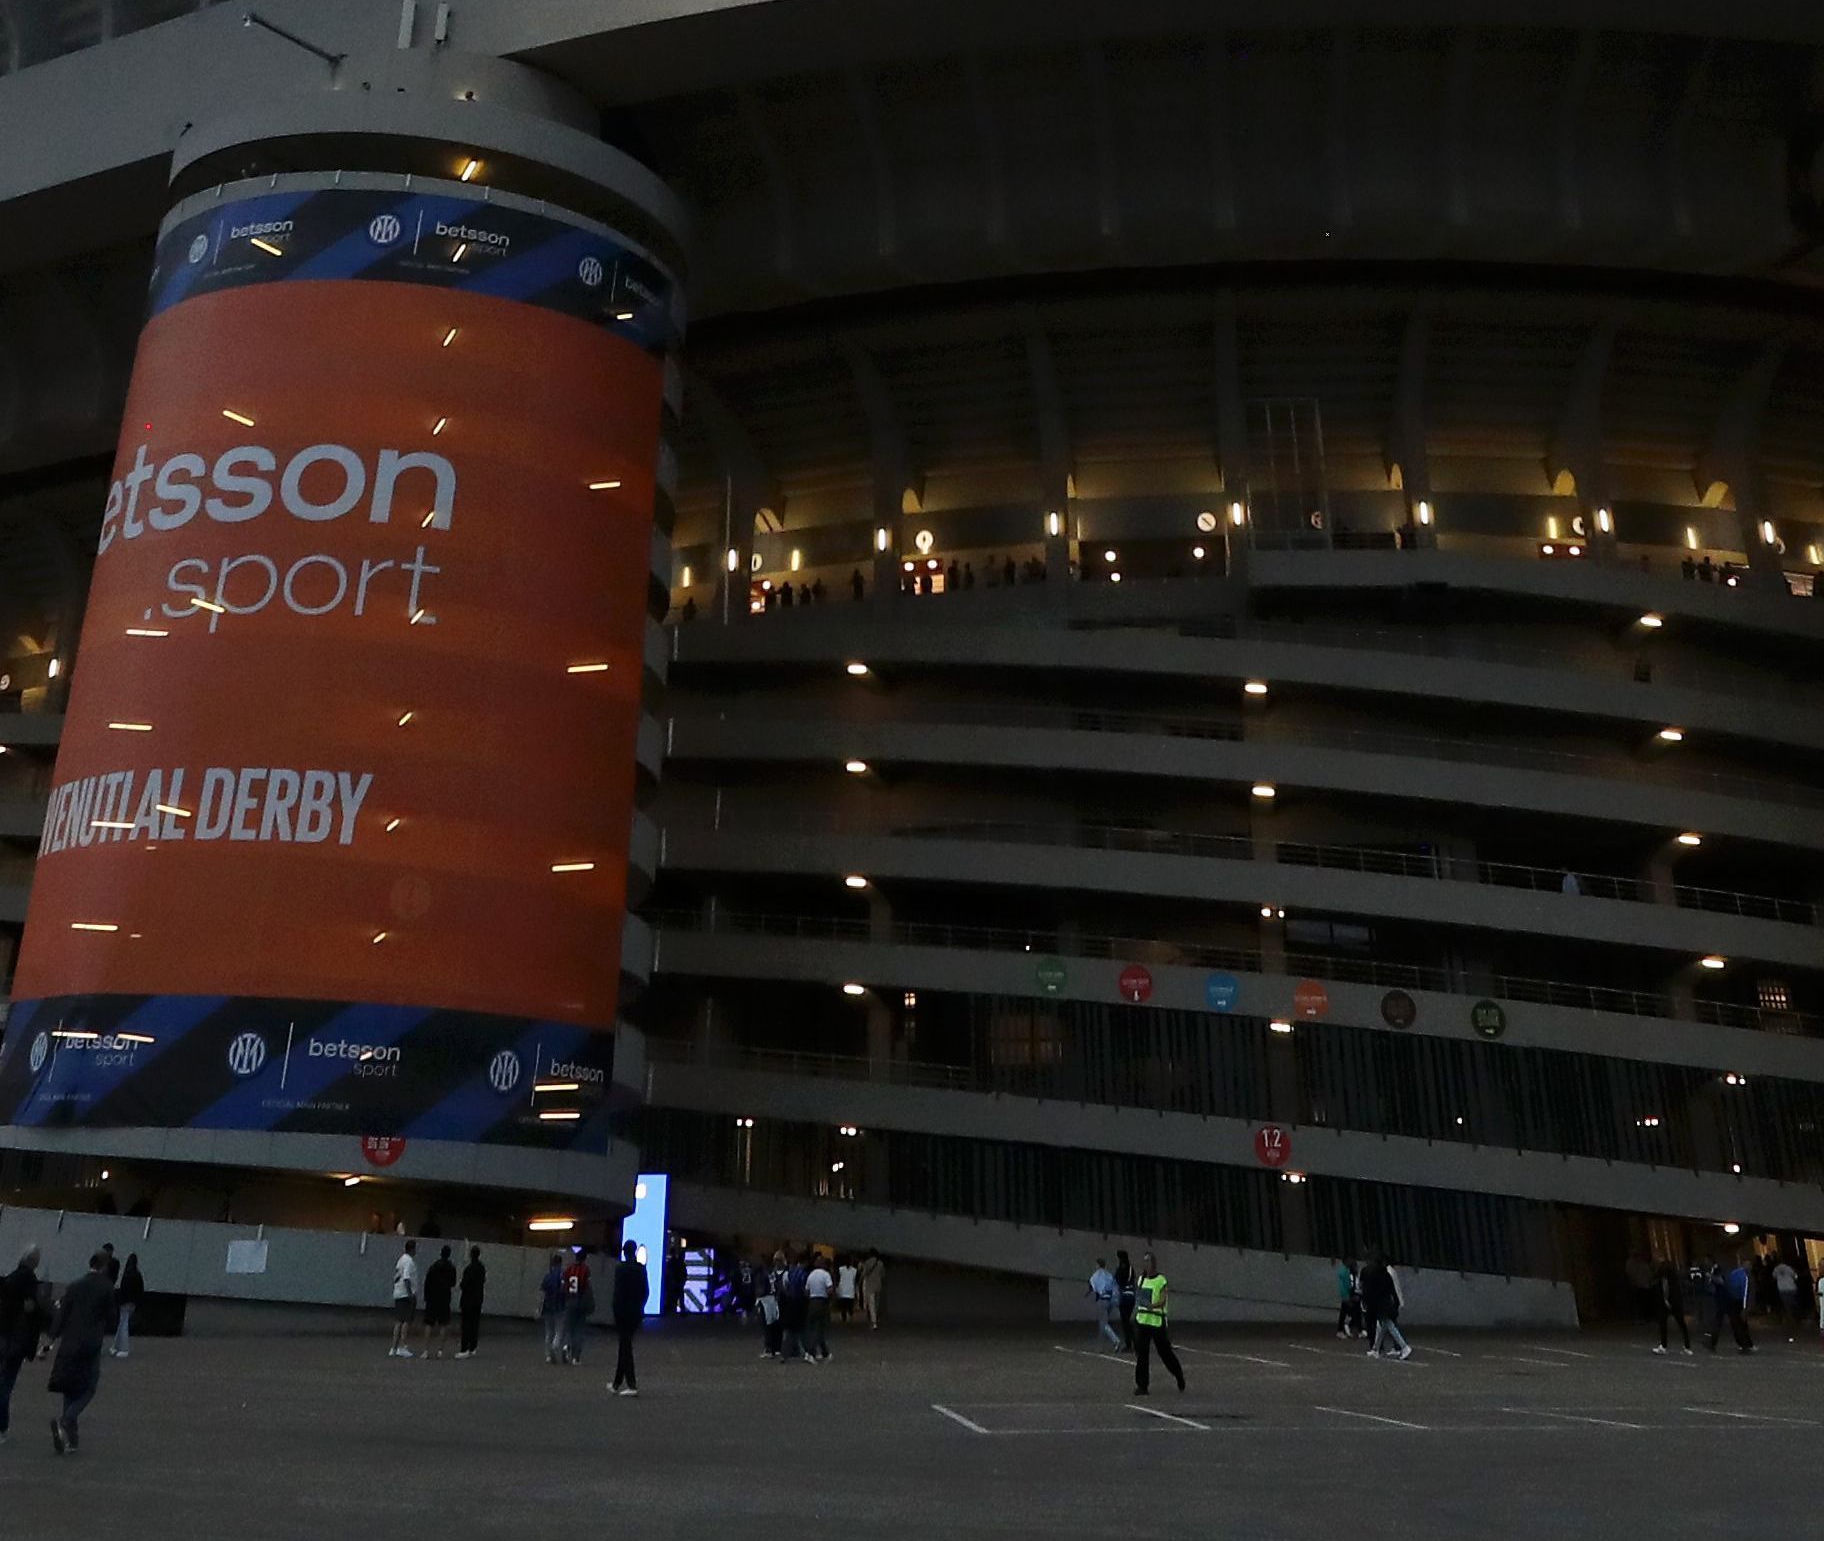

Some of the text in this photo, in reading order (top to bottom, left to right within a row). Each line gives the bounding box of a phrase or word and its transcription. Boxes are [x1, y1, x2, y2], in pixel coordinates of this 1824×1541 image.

[230, 220, 294, 239] betsson
[435, 220, 510, 247] betsson
[128, 767, 186, 841] AL
[195, 768, 374, 845] DERBY
[308, 1037, 401, 1062] betsson
[550, 1058, 604, 1083] betsson
[568, 1275, 579, 1294] 3
